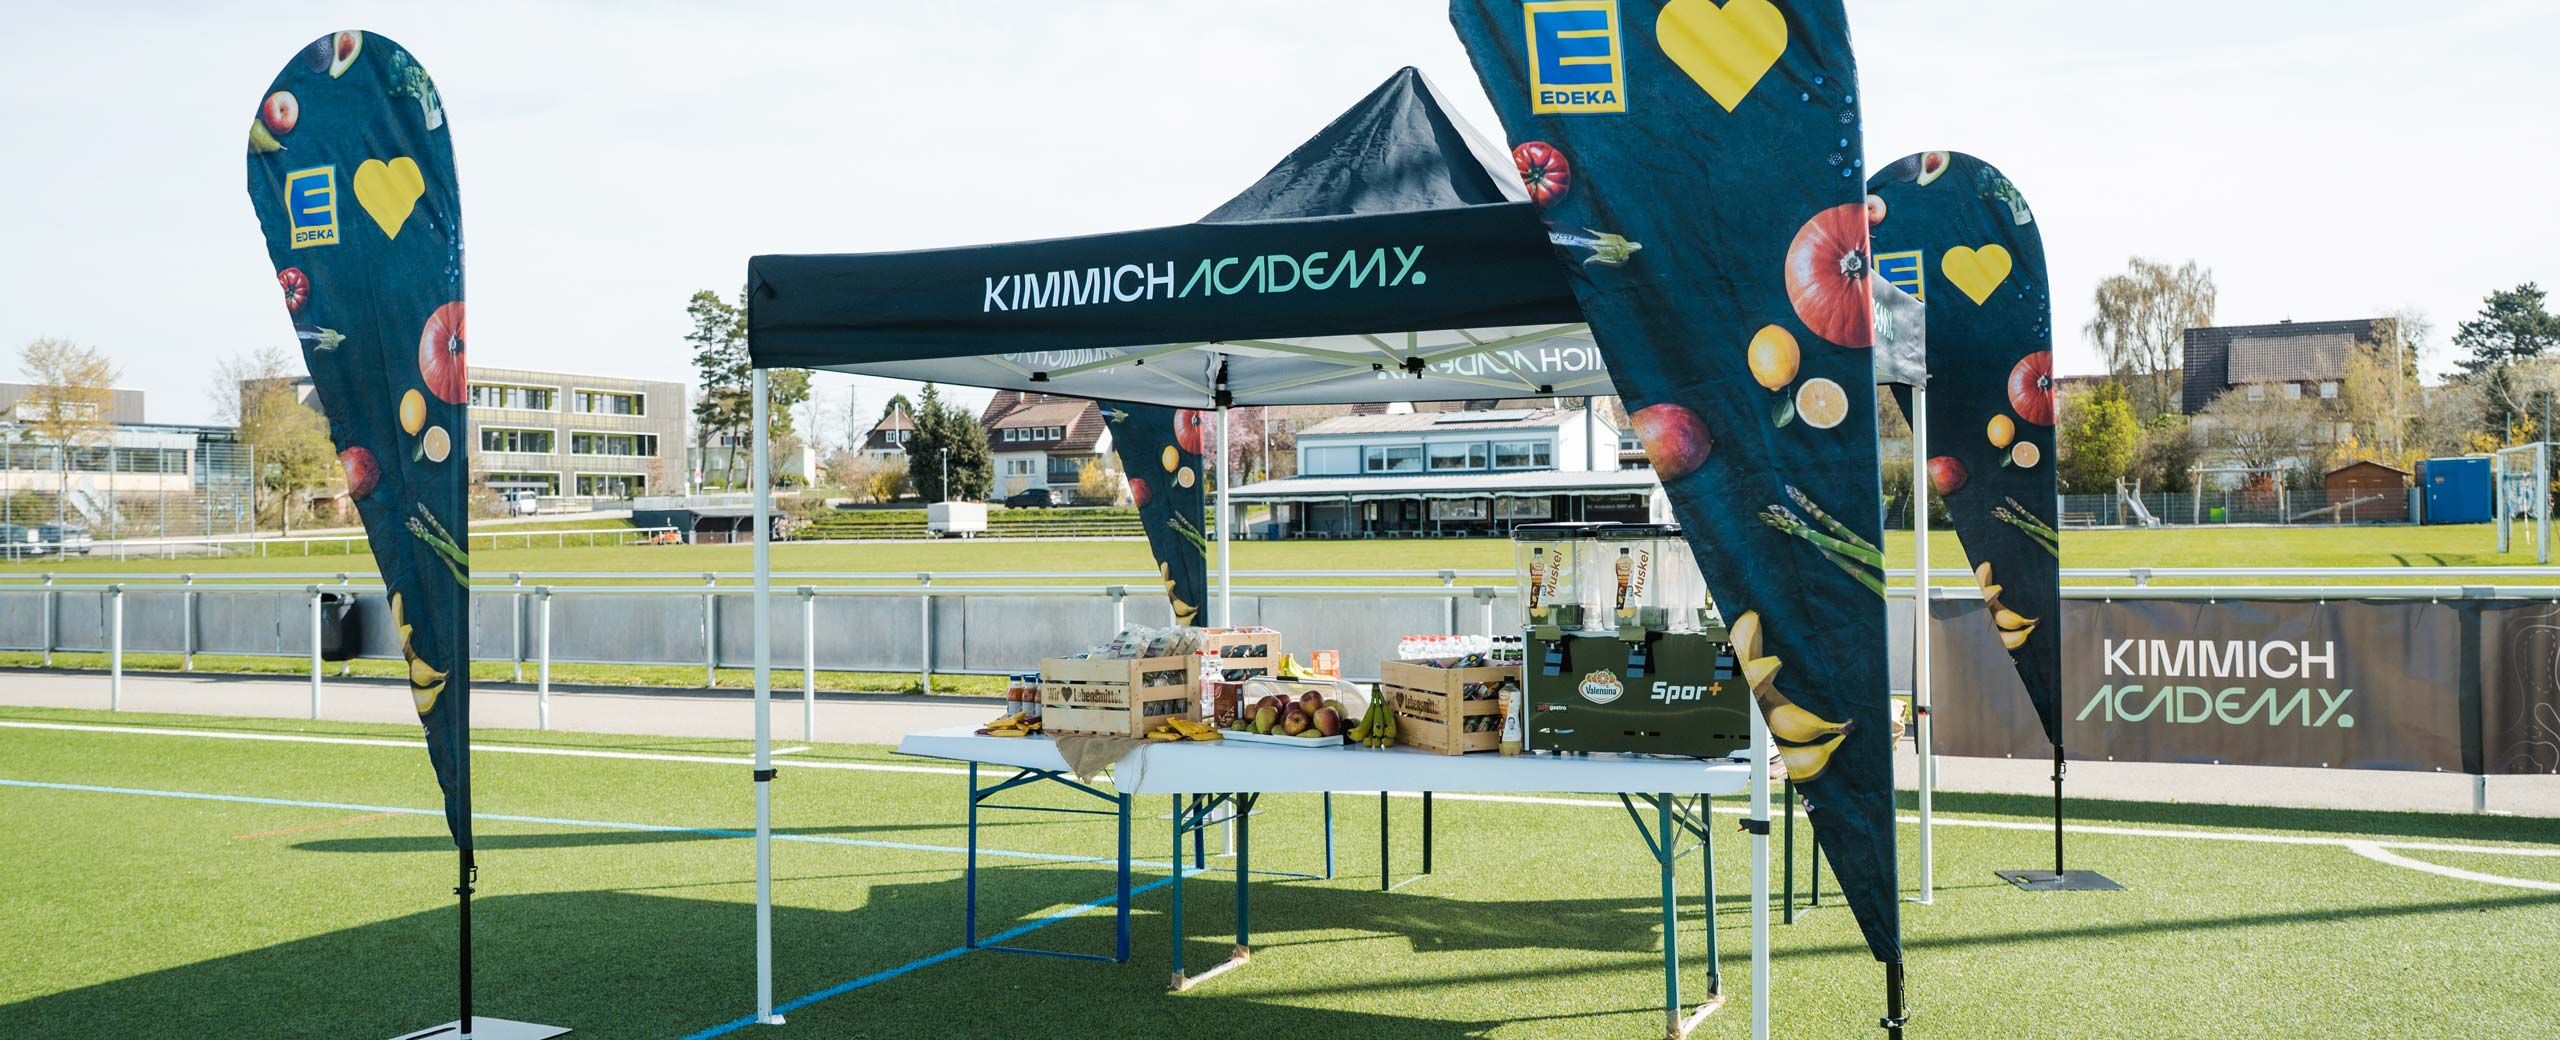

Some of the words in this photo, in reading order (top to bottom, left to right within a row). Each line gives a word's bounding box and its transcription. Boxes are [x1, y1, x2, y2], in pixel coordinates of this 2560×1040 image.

[1534, 10, 1613, 85] E
[1540, 90, 1617, 105] EDEKA
[291, 174, 333, 228] E
[296, 229, 334, 243] EDEKA
[983, 260, 1174, 312] KIMMICH
[1547, 550, 1562, 598] Muskel
[1634, 549, 1649, 598] Muskel
[2103, 639, 2335, 679] KIMMICH
[1047, 687, 1060, 701] Wir
[1586, 684, 1617, 696] Valensina
